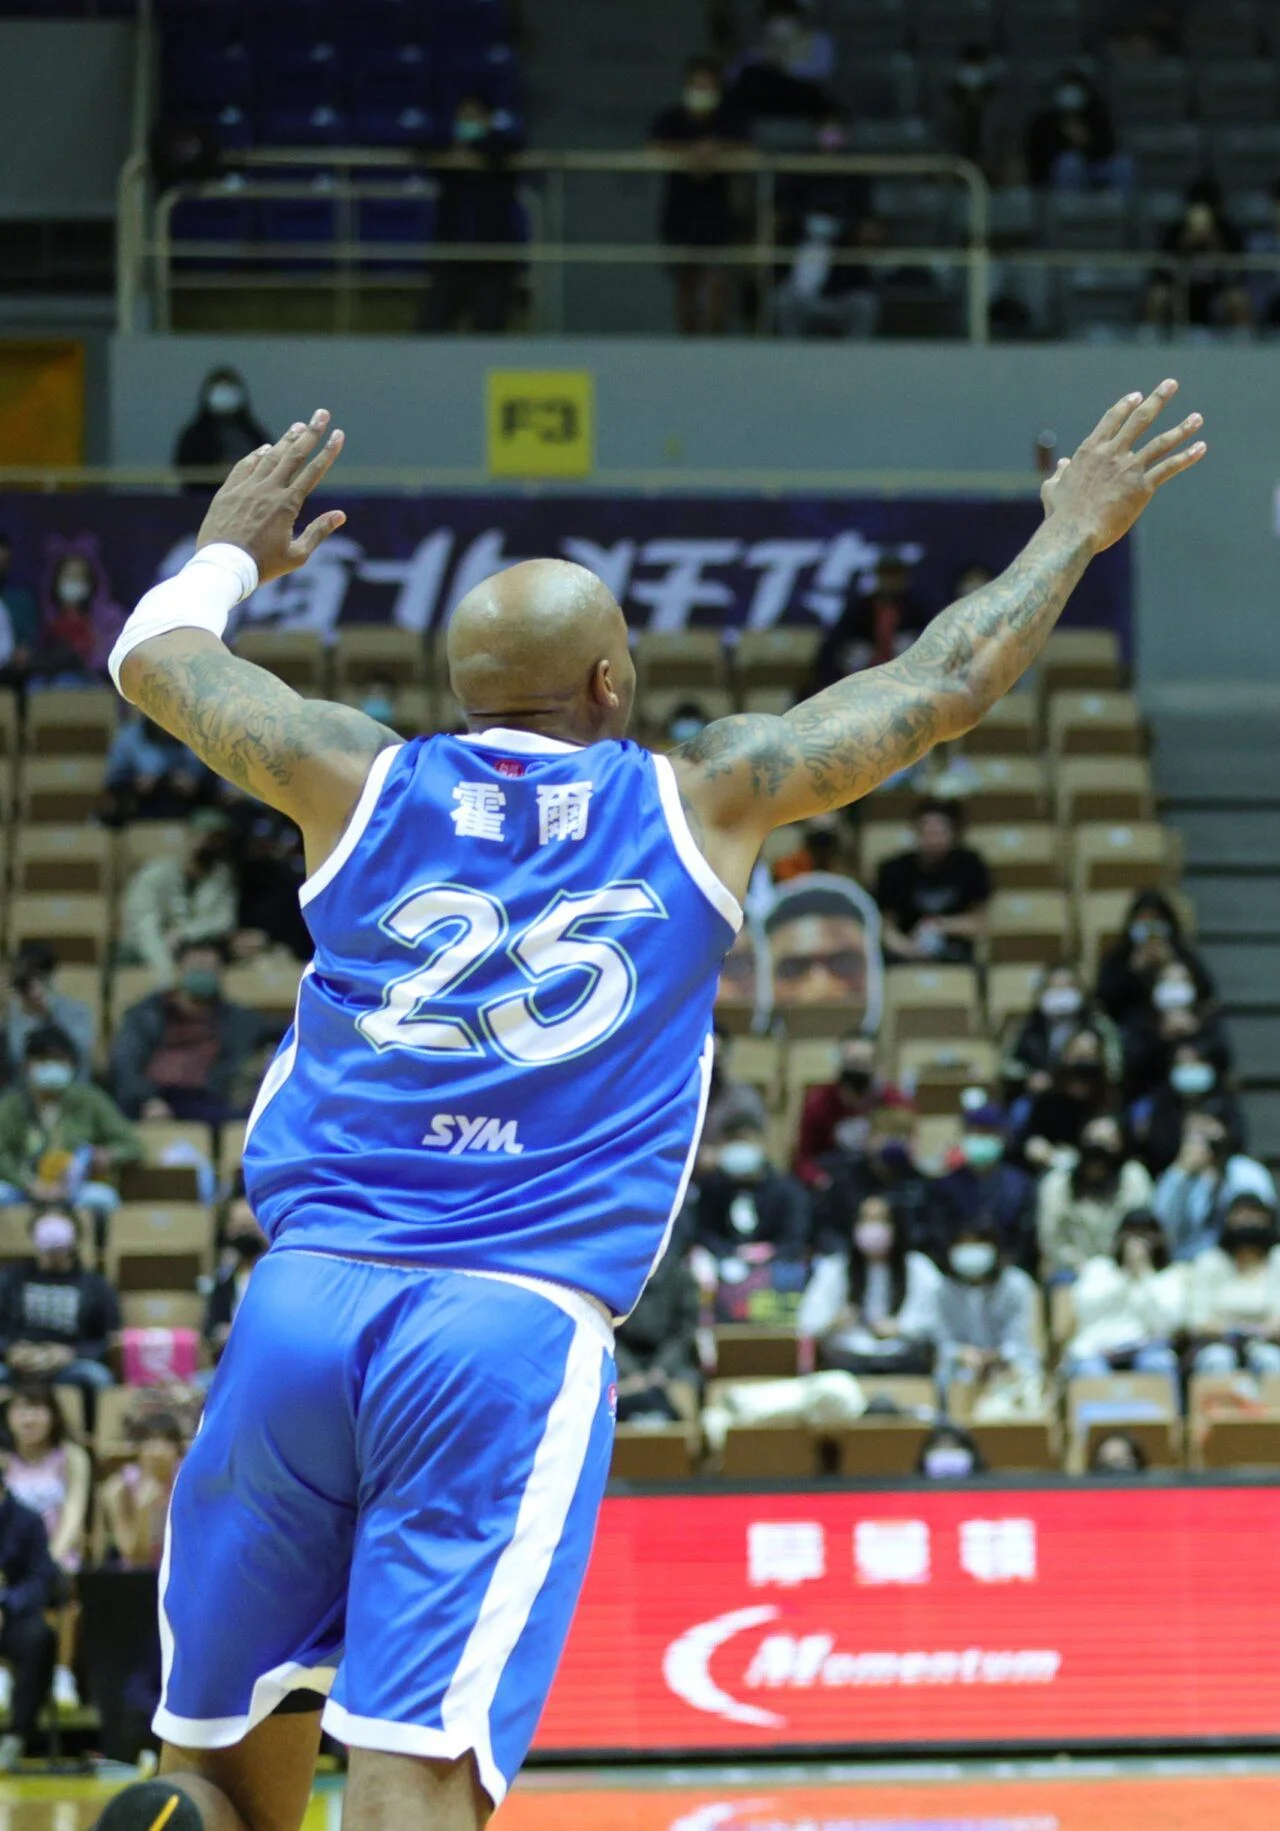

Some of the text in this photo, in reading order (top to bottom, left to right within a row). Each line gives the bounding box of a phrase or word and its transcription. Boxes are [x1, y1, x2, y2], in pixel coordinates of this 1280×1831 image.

[500, 397, 579, 446] F3
[451, 780, 594, 845] 霍爾
[354, 879, 670, 1067] 25
[421, 1112, 524, 1156] SYM
[743, 1631, 1062, 1688] Momentum
